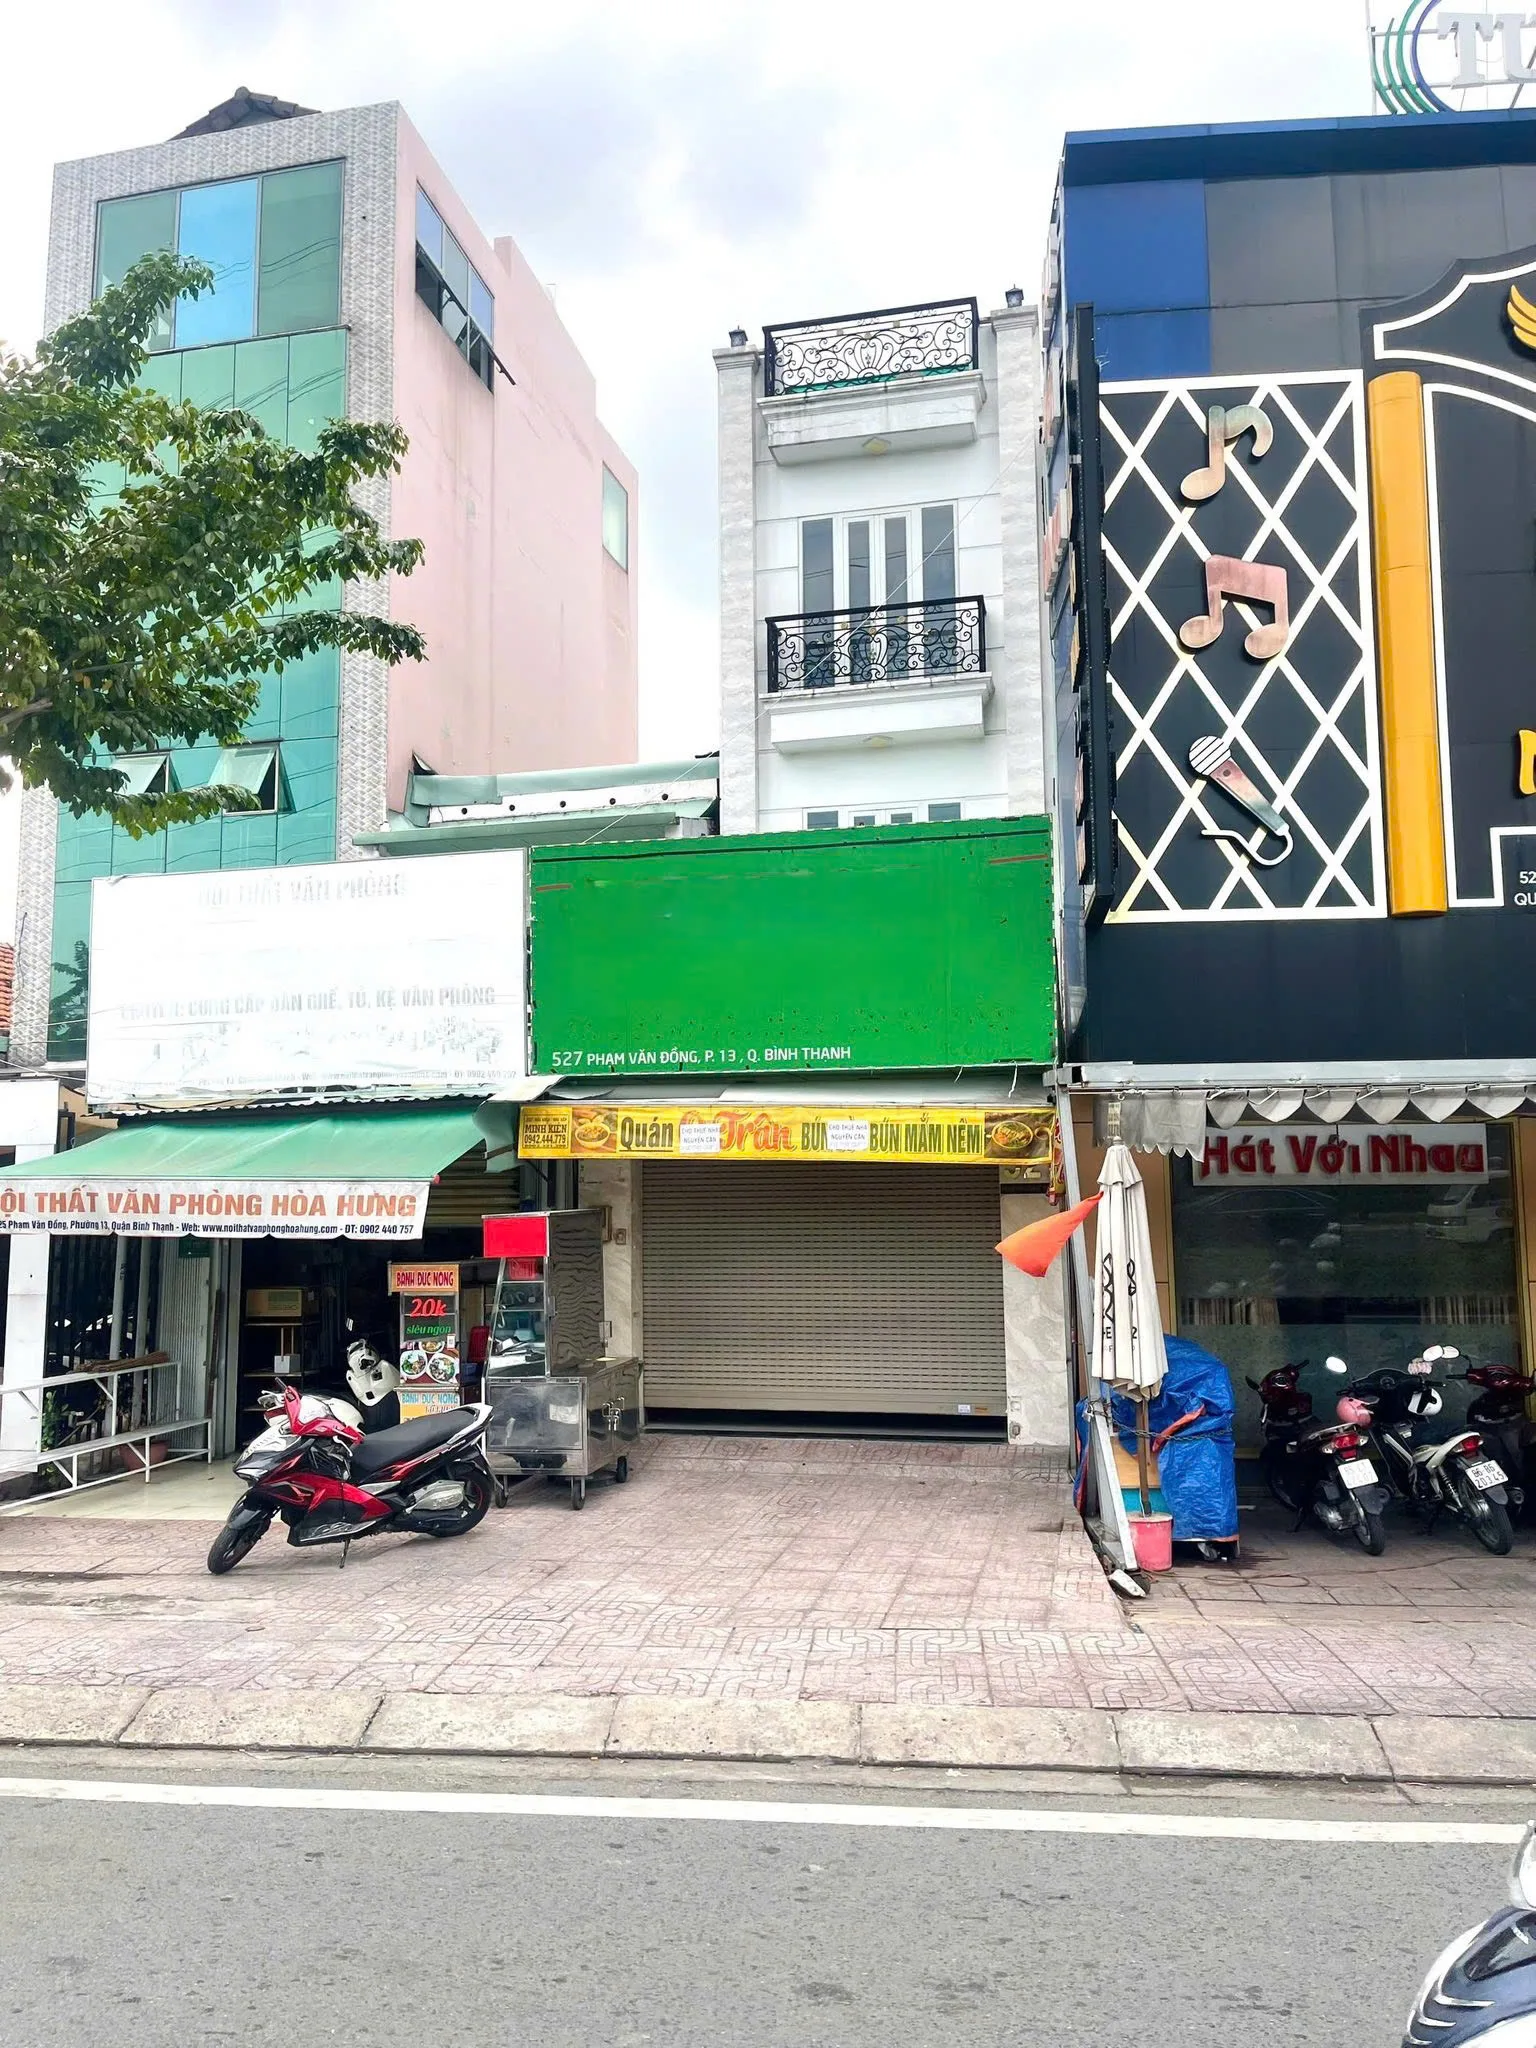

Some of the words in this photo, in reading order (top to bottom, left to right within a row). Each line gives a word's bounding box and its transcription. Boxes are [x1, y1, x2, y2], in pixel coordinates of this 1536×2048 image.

[552, 1051, 582, 1067] 527
[587, 1051, 625, 1068] PHẠM
[629, 1048, 657, 1065] VĂN
[660, 1046, 701, 1065] ĐỒNG,
[705, 1050, 715, 1062] P.
[720, 1049, 736, 1063] 13
[747, 1049, 760, 1062] Q.
[764, 1044, 798, 1061] BÌNH
[801, 1046, 851, 1062] THẠNH
[525, 1124, 546, 1133] MINH
[620, 1116, 674, 1150] Quán
[869, 1117, 900, 1152] BÚN
[904, 1112, 942, 1153] MẮM
[1201, 1135, 1276, 1176] Hát
[1286, 1133, 1362, 1175] Với
[1368, 1134, 1484, 1174] Nhau
[34, 1184, 99, 1213] THẤT
[107, 1188, 160, 1214] VĂN
[169, 1189, 262, 1217] PHÒNG
[271, 1189, 327, 1217] HÒA
[336, 1192, 417, 1217] HƯNG
[8, 1220, 30, 1231] Phạm
[70, 1220, 100, 1231] Phường
[111, 1221, 131, 1232] Quận
[152, 1222, 174, 1233] Thạnh
[182, 1222, 200, 1232] Web:
[202, 1223, 338, 1234] www.noithatvanphonghoahung.com
[360, 1224, 379, 1234] 0902
[382, 1224, 398, 1234] 440
[399, 1224, 414, 1234] 757
[409, 1298, 447, 1318] 20k
